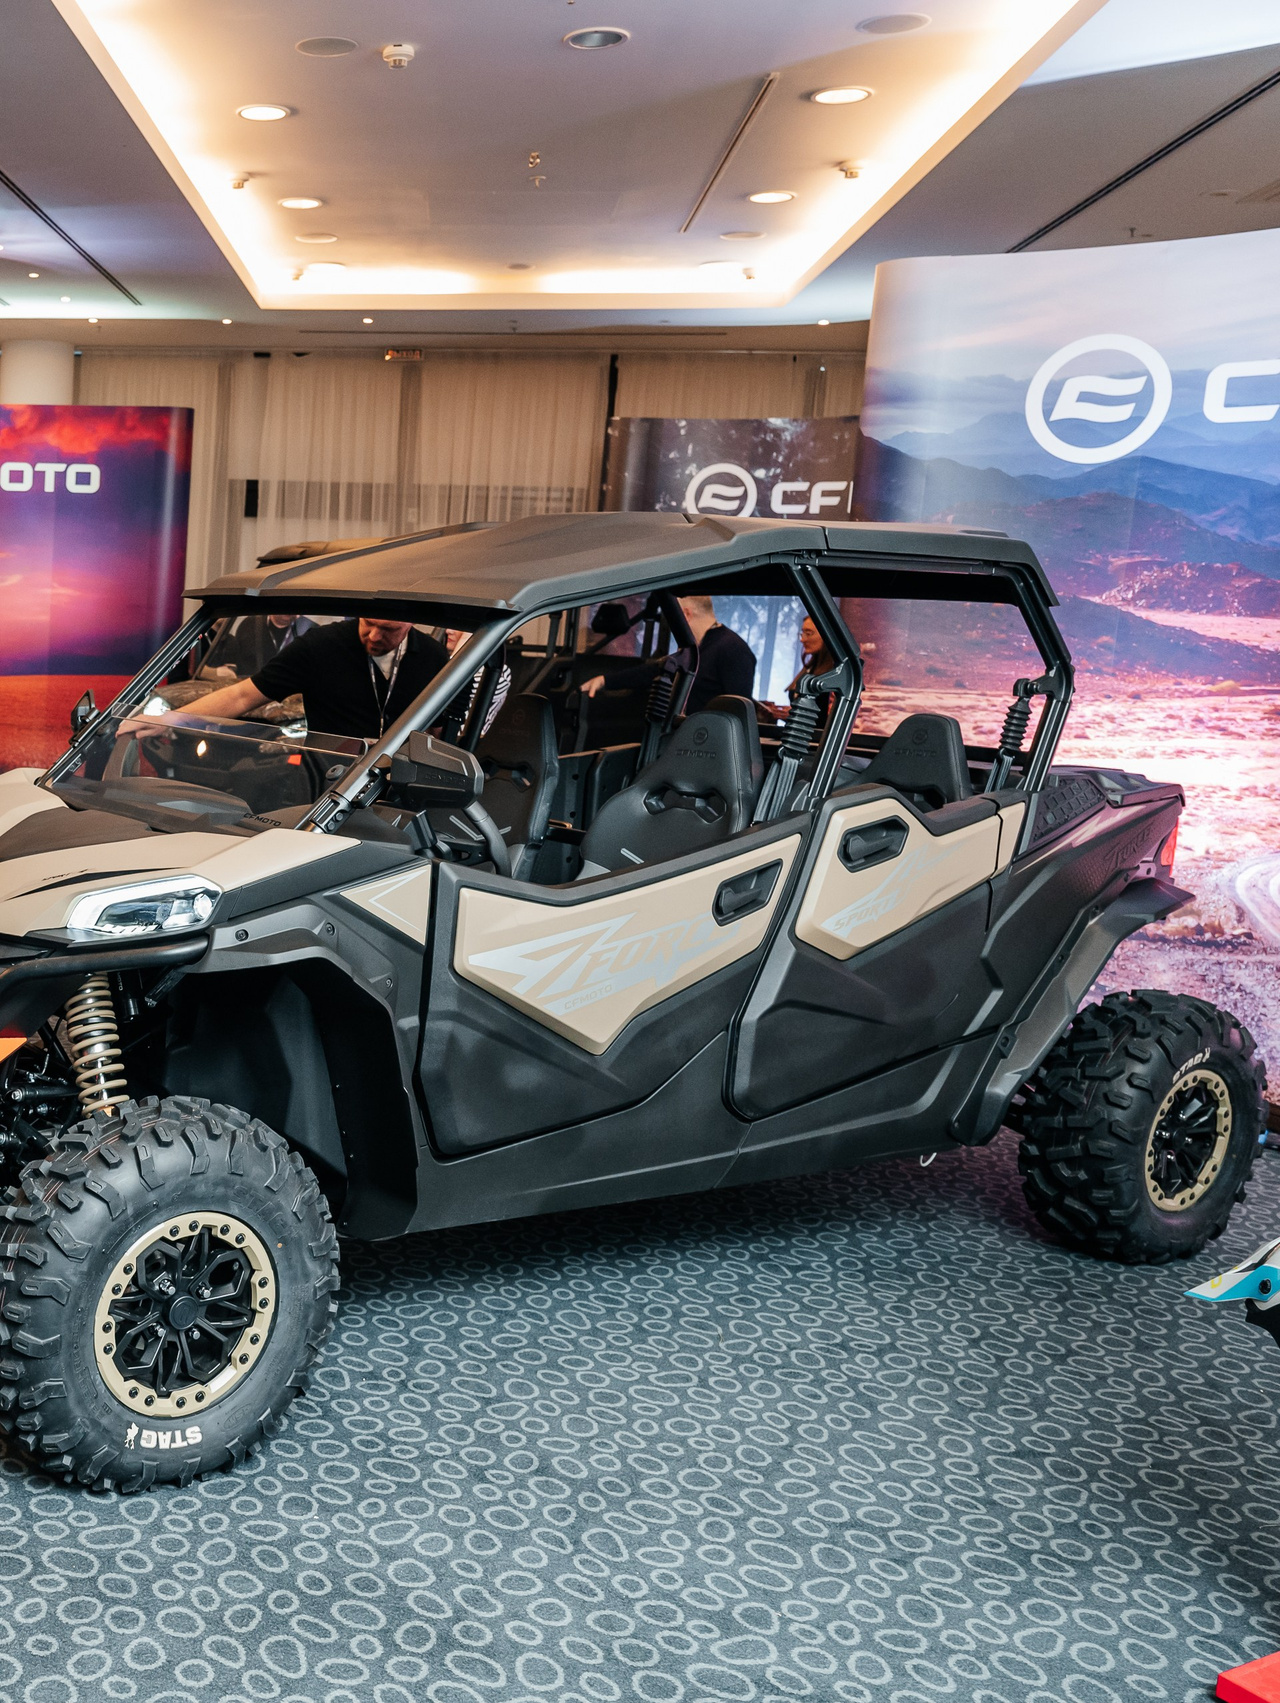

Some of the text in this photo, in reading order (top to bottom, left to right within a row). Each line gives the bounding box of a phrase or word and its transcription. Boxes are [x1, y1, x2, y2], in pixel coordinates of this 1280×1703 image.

[770, 480, 854, 515] CF
[243, 812, 282, 827] CFMOTO
[564, 984, 613, 1010] CFMOTO
[140, 1425, 203, 1450] STAG
